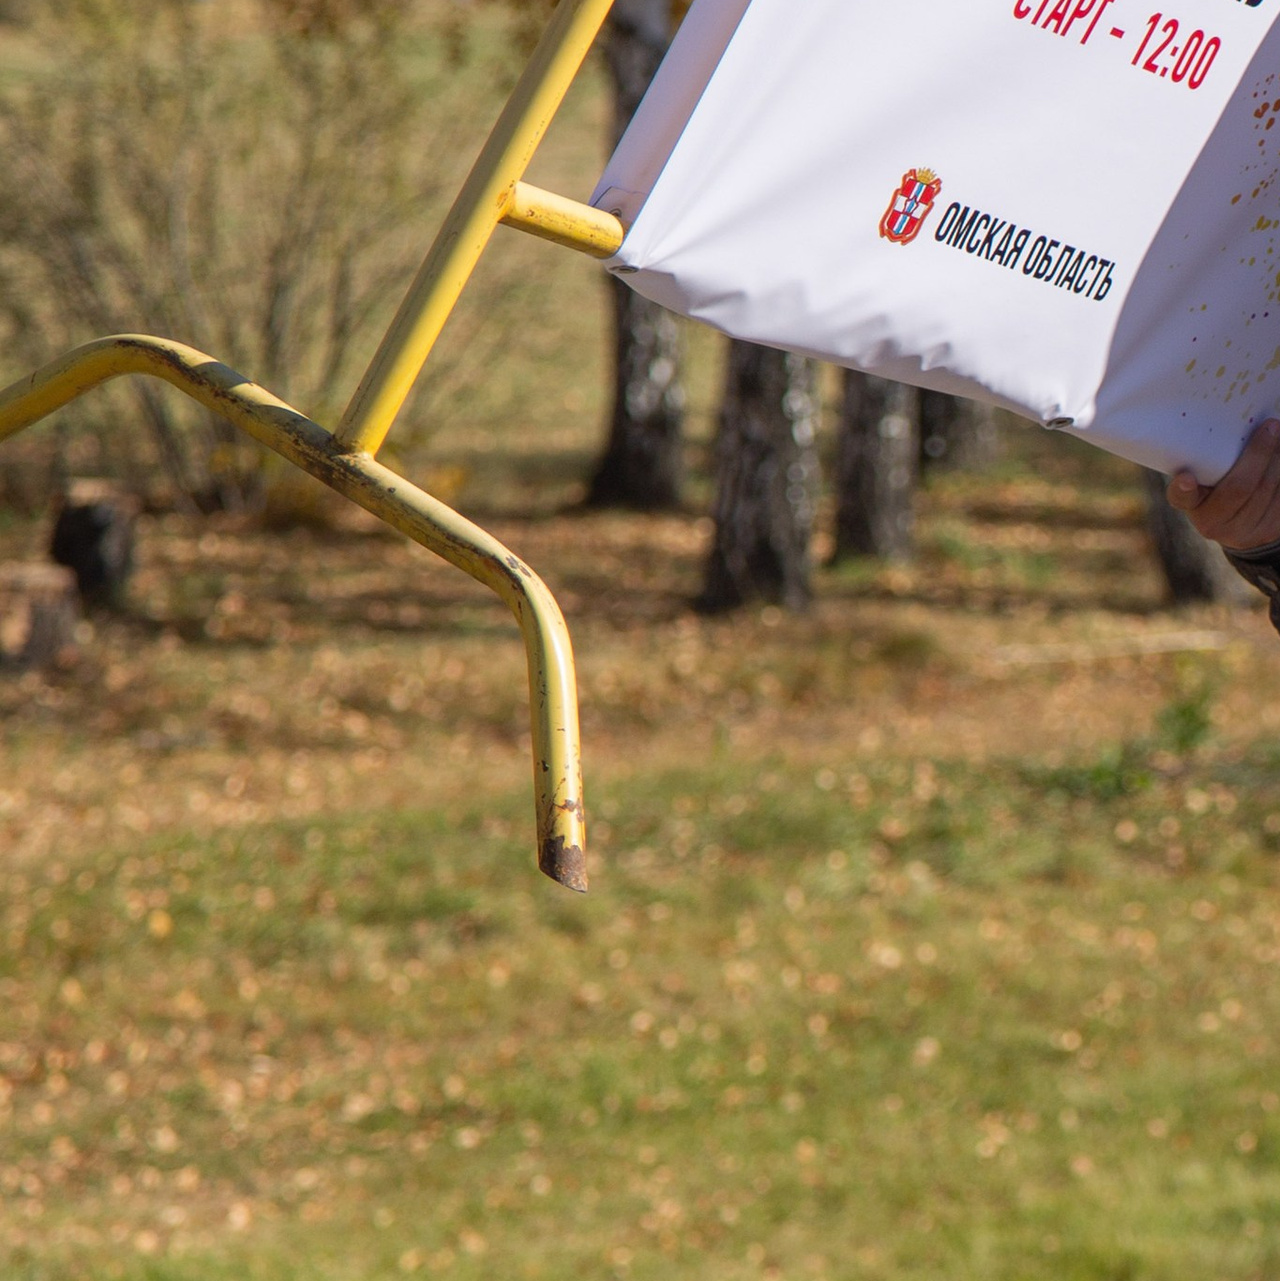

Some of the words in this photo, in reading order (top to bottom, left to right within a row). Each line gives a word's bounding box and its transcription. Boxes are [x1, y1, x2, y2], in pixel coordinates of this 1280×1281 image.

[1130, 12, 1222, 91] 12:00
[934, 201, 1032, 270] ОМСКАЯ
[1022, 235, 1116, 302] ОБЛАСТЬ
